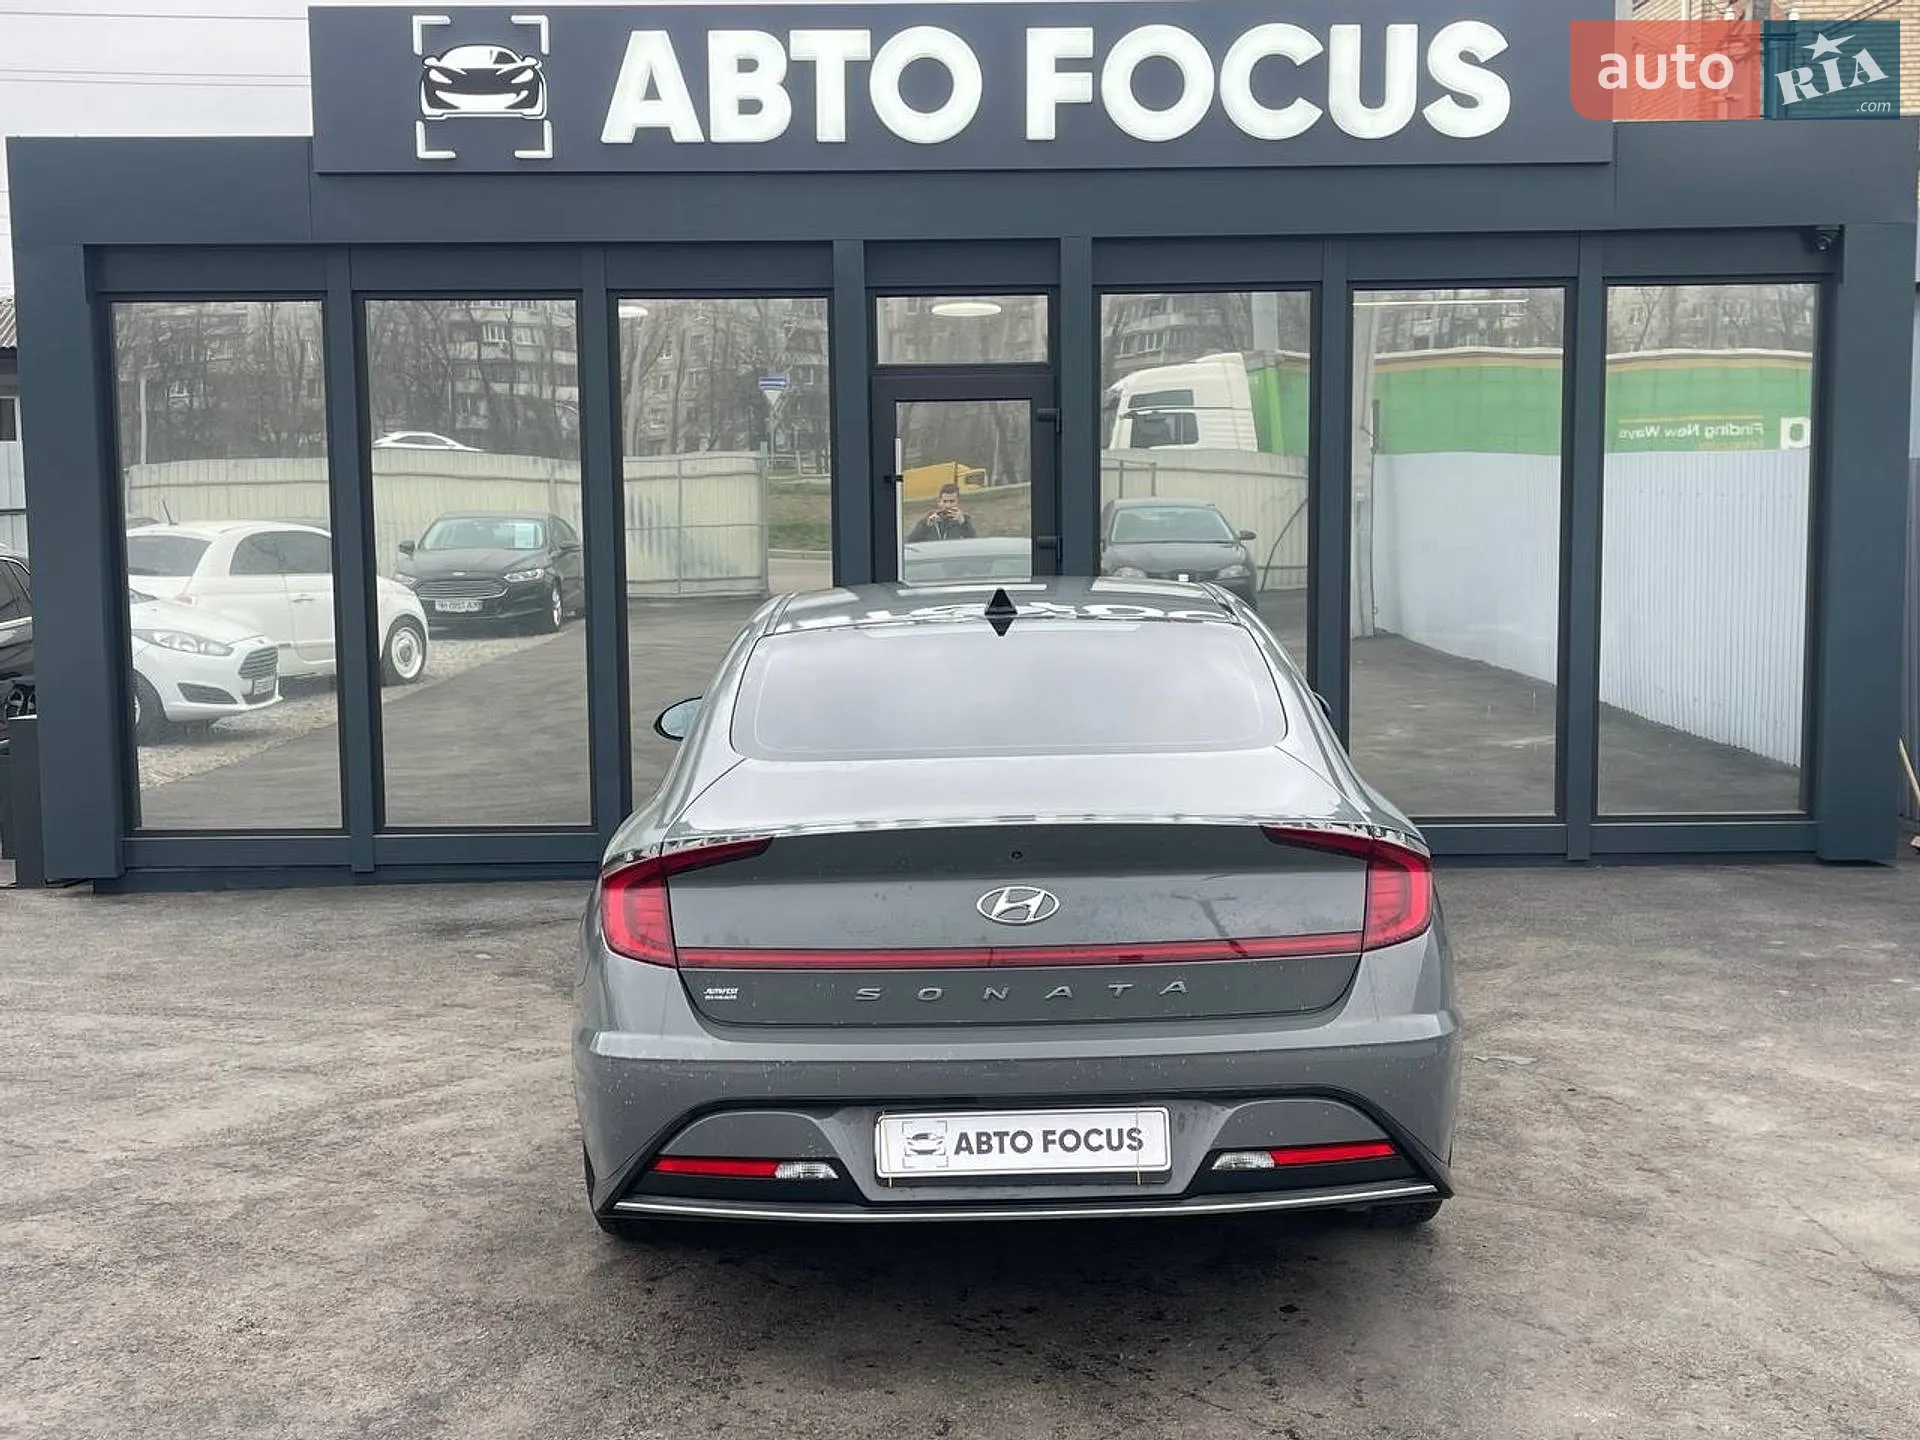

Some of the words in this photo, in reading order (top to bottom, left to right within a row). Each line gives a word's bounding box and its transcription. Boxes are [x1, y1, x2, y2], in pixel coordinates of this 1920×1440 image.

[601, 25, 984, 145] АВТО
[1026, 20, 1511, 142] FOCUS
[854, 980, 1188, 1001] SONATA
[954, 1130, 1034, 1155] АВТО
[1042, 1127, 1144, 1153] FOCUS
